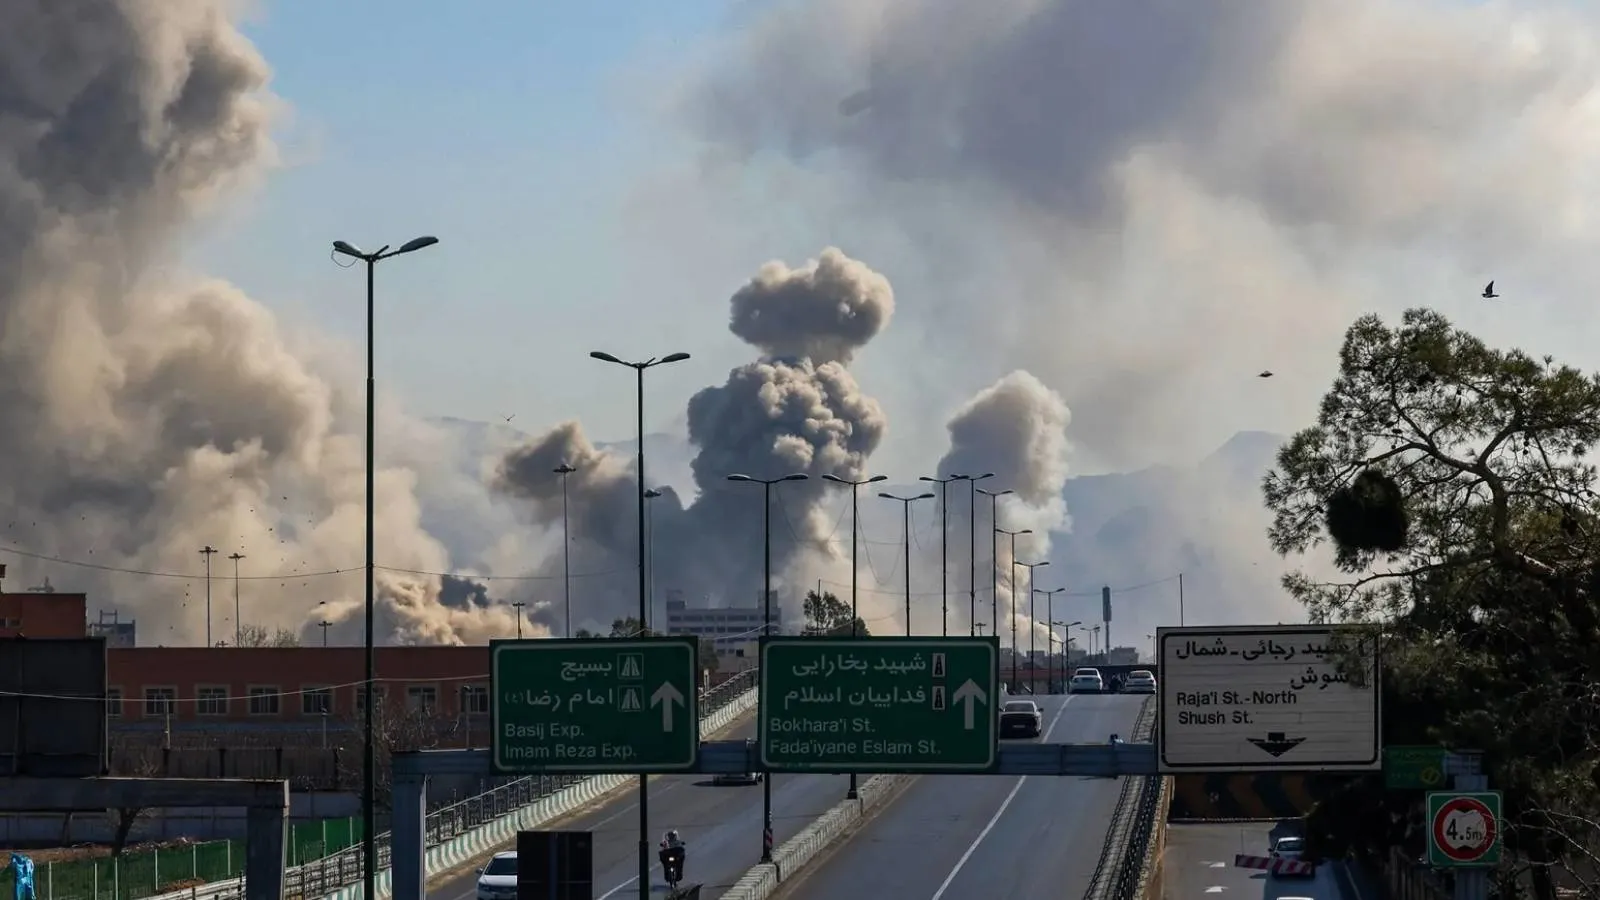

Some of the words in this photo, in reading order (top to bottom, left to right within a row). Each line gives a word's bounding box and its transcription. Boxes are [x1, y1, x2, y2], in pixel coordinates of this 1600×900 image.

[561, 661, 612, 681] بسیج
[792, 653, 868, 676] بخارایی
[873, 653, 926, 675] شهید
[569, 687, 613, 712] امام
[784, 686, 841, 710] اسلام
[848, 685, 926, 708] فداییان
[1176, 691, 1218, 708] Raja'i
[770, 718, 847, 733] Bokhara'i
[852, 718, 876, 733] St.
[1178, 711, 1226, 725] Shush
[1231, 710, 1254, 725] St.
[505, 722, 545, 741] Basij
[550, 722, 585, 740] Exp.
[505, 744, 550, 759] Imam
[555, 743, 597, 758] Reza
[601, 742, 637, 760] Exp.
[770, 739, 857, 757] Fada'iyane
[862, 739, 913, 755] Eslam
[917, 739, 942, 754] St.
